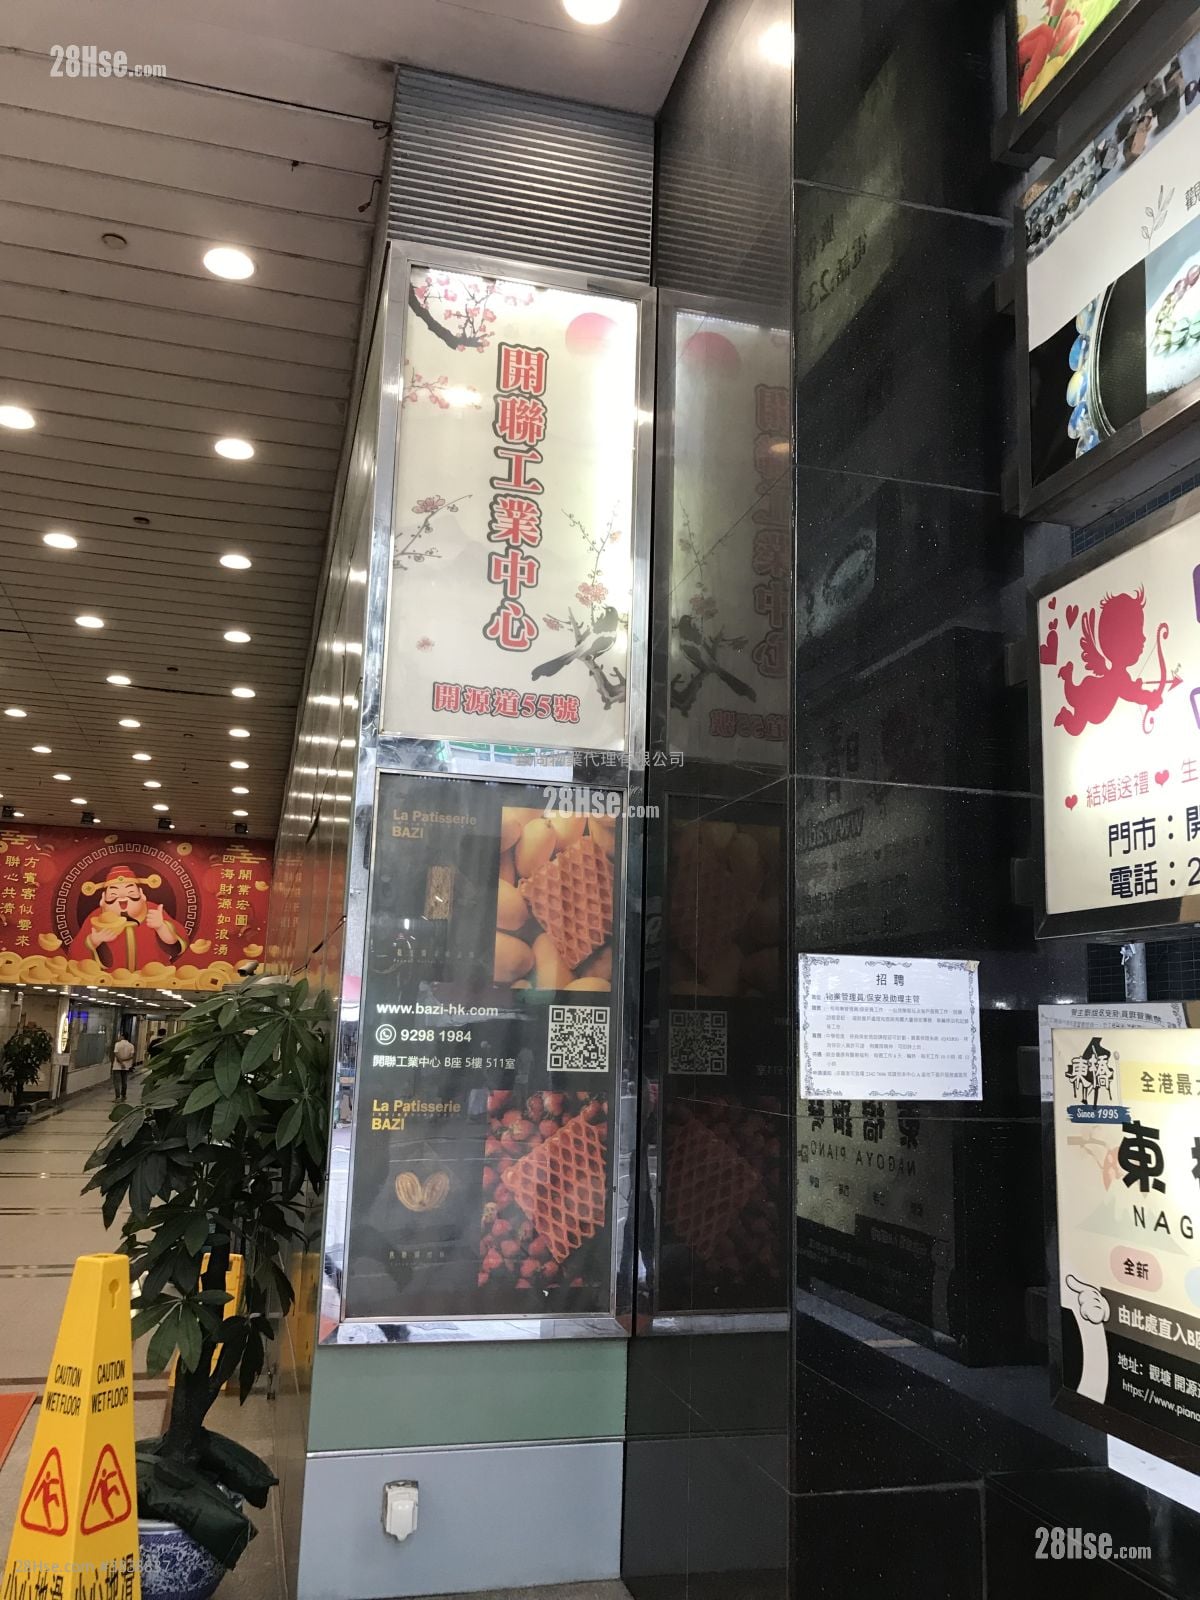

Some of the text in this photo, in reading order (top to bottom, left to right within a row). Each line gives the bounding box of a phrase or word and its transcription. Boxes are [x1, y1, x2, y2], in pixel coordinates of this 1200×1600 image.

[482, 341, 549, 652] 開聯工業中心
[432, 682, 581, 724] 開源道55號
[1086, 771, 1150, 808] 結婚送禮
[393, 809, 477, 826] La Patisserie
[391, 826, 424, 839] BAZI
[376, 1002, 499, 1017] www.bazi-hk.com
[400, 1029, 472, 1043] 9298 1984
[372, 1055, 441, 1069] 開聯工業中心
[465, 1057, 482, 1070] 5樓
[486, 1058, 516, 1071] 511室
[1140, 1071, 1200, 1097] 全港最
[372, 1099, 462, 1114] La Patisserie
[1076, 1107, 1119, 1120] Since 1995
[371, 1117, 405, 1131] BAZI
[1123, 1257, 1149, 1281] 全新
[1117, 1304, 1200, 1351] 由此處直入B
[54, 1364, 82, 1387] CAUTION
[97, 1359, 125, 1384] CAUTION
[1148, 1363, 1172, 1388] 觀塘
[1174, 1372, 1200, 1399] 開源
